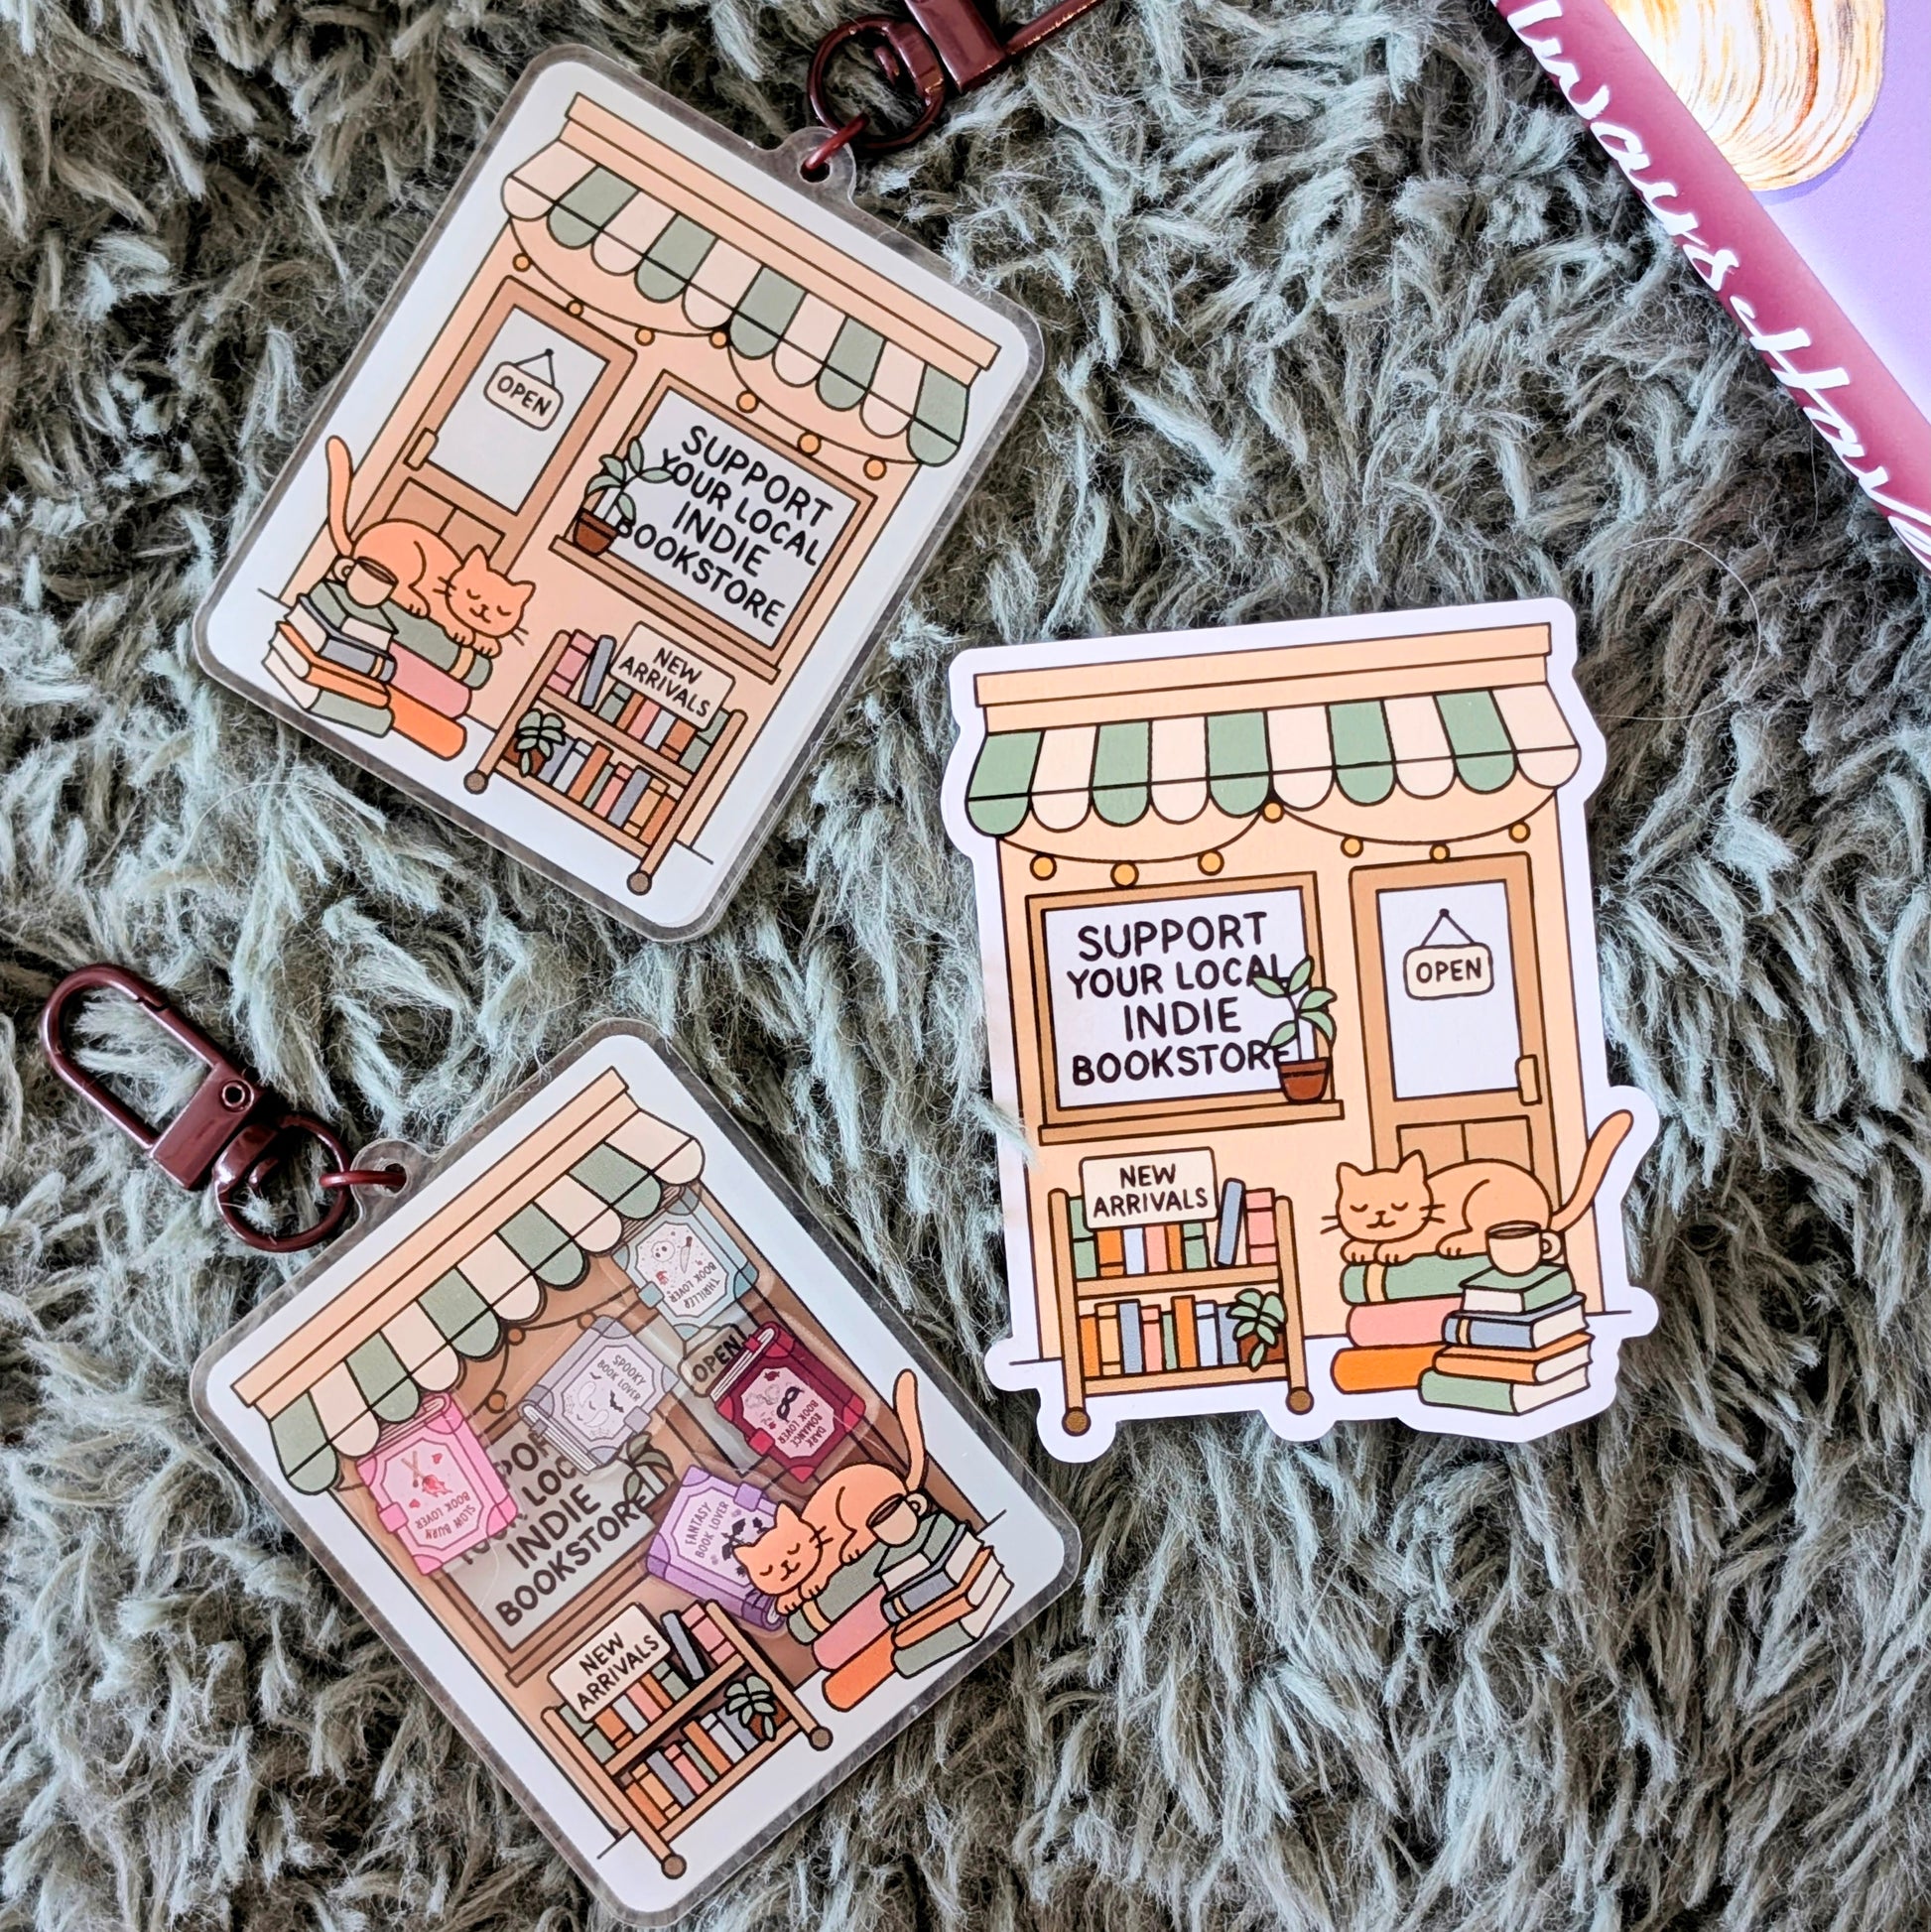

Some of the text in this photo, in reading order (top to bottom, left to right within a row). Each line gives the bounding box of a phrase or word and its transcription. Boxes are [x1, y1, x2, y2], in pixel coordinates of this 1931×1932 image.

[1490, 0, 1739, 292] lways
[496, 374, 553, 418] OPEN
[682, 425, 834, 527] SUPPORT
[662, 448, 820, 567] YOUR LOCAL
[672, 500, 771, 578] INDIE
[614, 518, 786, 628] BOOKSTORE
[618, 656, 711, 719] ARRIVALS
[654, 646, 703, 685] NEW
[1077, 911, 1267, 963] SUPPORT
[1067, 953, 1291, 1000] YOUR LOCAL
[1415, 957, 1482, 985] OPEN
[1123, 996, 1241, 1042] INDIE
[1119, 1163, 1177, 1190] NEW
[1093, 1188, 1210, 1220] ARRIVALS
[669, 1261, 717, 1303] BOOK LOVER
[684, 1278, 720, 1309] THRILLER
[597, 1359, 641, 1402] BOOK LOVER
[612, 1354, 647, 1386] SPOOKY
[692, 1334, 743, 1383] OPEN
[777, 1399, 820, 1444] BOOK LOVER
[790, 1412, 824, 1448] ROMANCE
[805, 1426, 827, 1449] DARK
[521, 1455, 578, 1507] LOC
[415, 1491, 470, 1529] BOOK LOVER
[425, 1504, 476, 1540] SLOW BURN
[506, 1483, 601, 1570] INDIE
[685, 1501, 712, 1545] FANTASY
[695, 1500, 729, 1559] BOOK LOVER
[495, 1494, 648, 1627] BOOKSTORE
[576, 1634, 661, 1714] ARRIVALS
[579, 1631, 625, 1677] NEW
